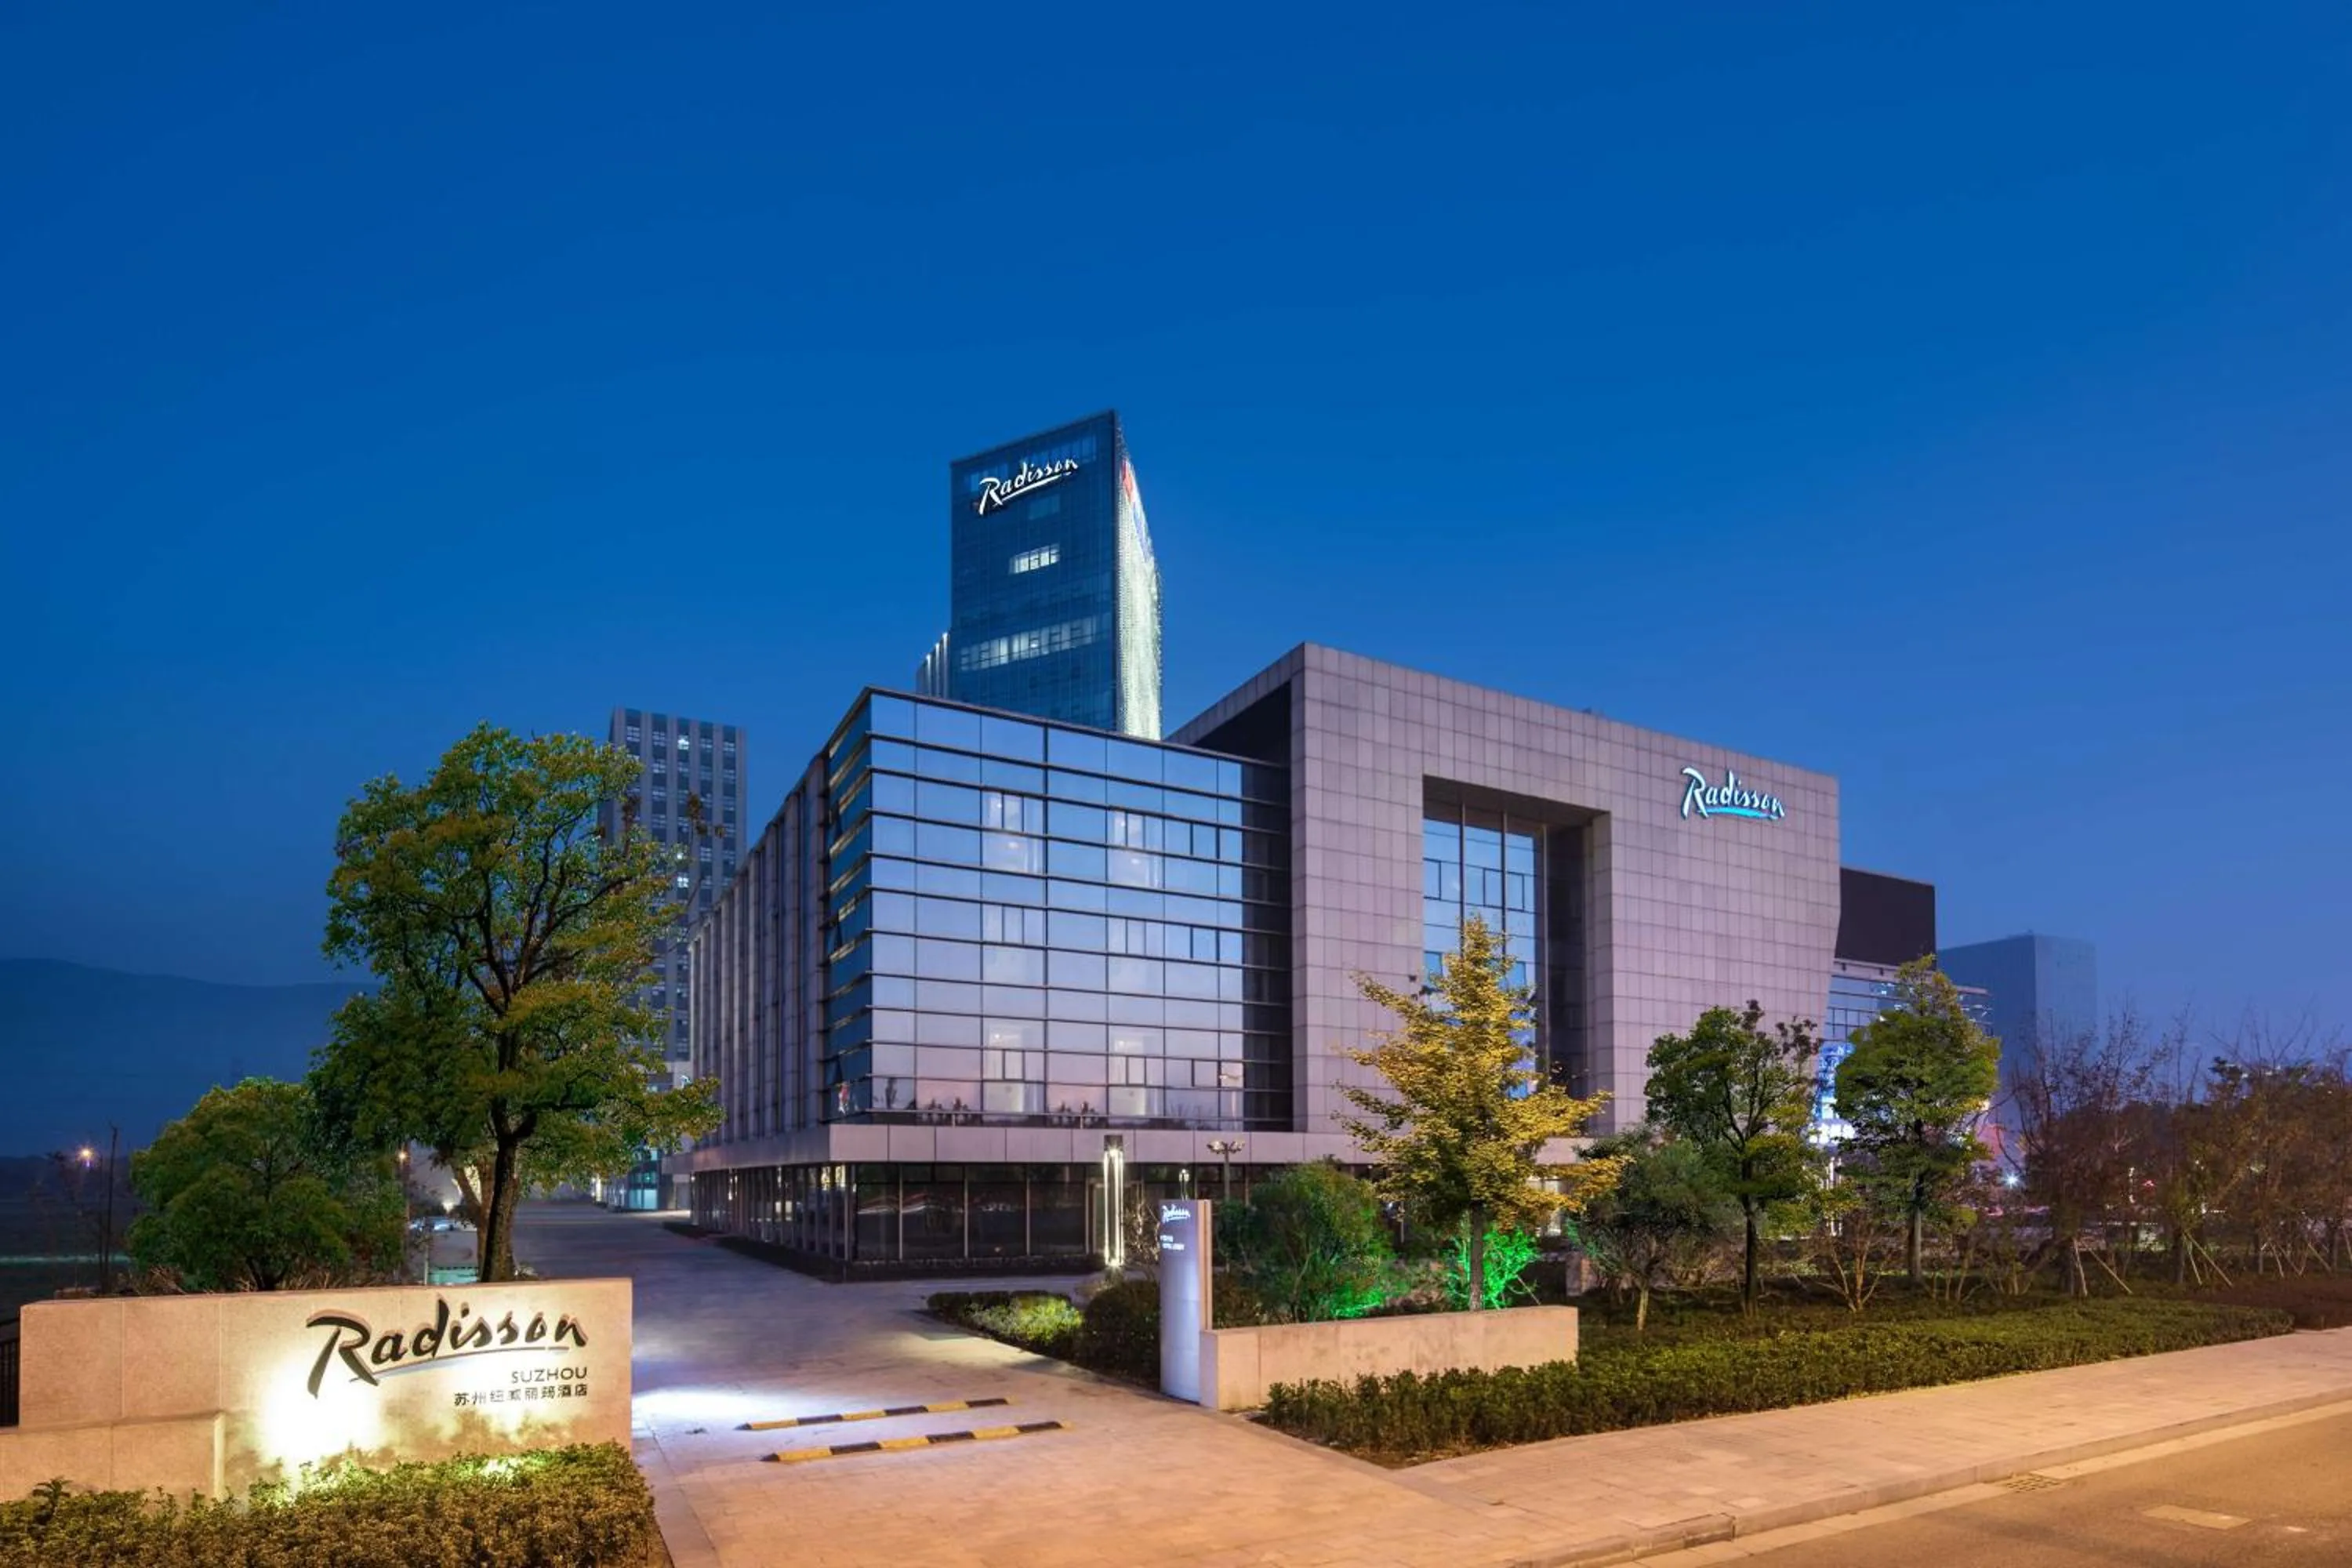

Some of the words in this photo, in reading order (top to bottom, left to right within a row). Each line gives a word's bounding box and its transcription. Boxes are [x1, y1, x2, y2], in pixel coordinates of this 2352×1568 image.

[978, 456, 1080, 516] Radisson
[1681, 766, 1785, 819] Radisson
[306, 1293, 589, 1398] Radisson
[511, 1367, 587, 1384] SUZHOU
